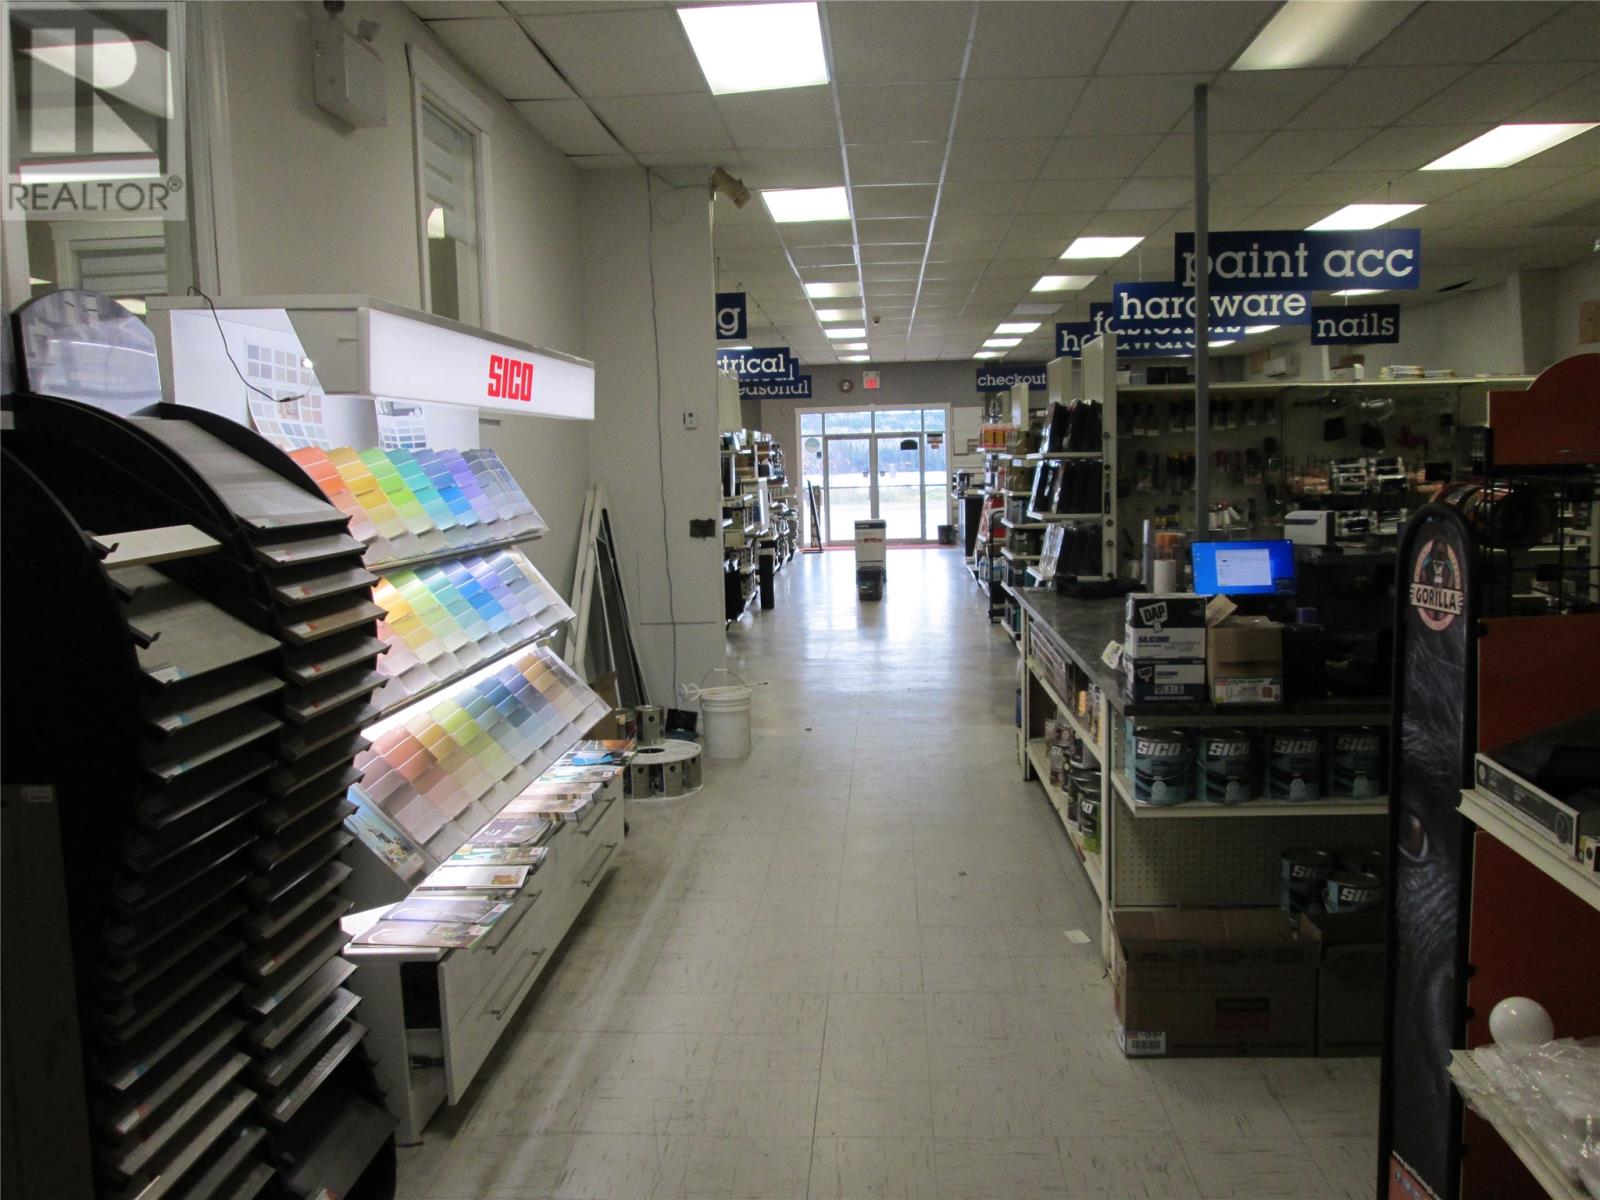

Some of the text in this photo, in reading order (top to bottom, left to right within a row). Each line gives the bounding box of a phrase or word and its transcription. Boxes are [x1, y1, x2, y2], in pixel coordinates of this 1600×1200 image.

[1323, 248, 1414, 278] acc
[1317, 313, 1396, 338] nails
[717, 353, 786, 375] trical
[487, 354, 534, 402] SICO
[977, 373, 1046, 388] checkout
[1415, 587, 1457, 611] GORILLA
[1144, 604, 1166, 623] DAP
[1136, 740, 1181, 757] SICO
